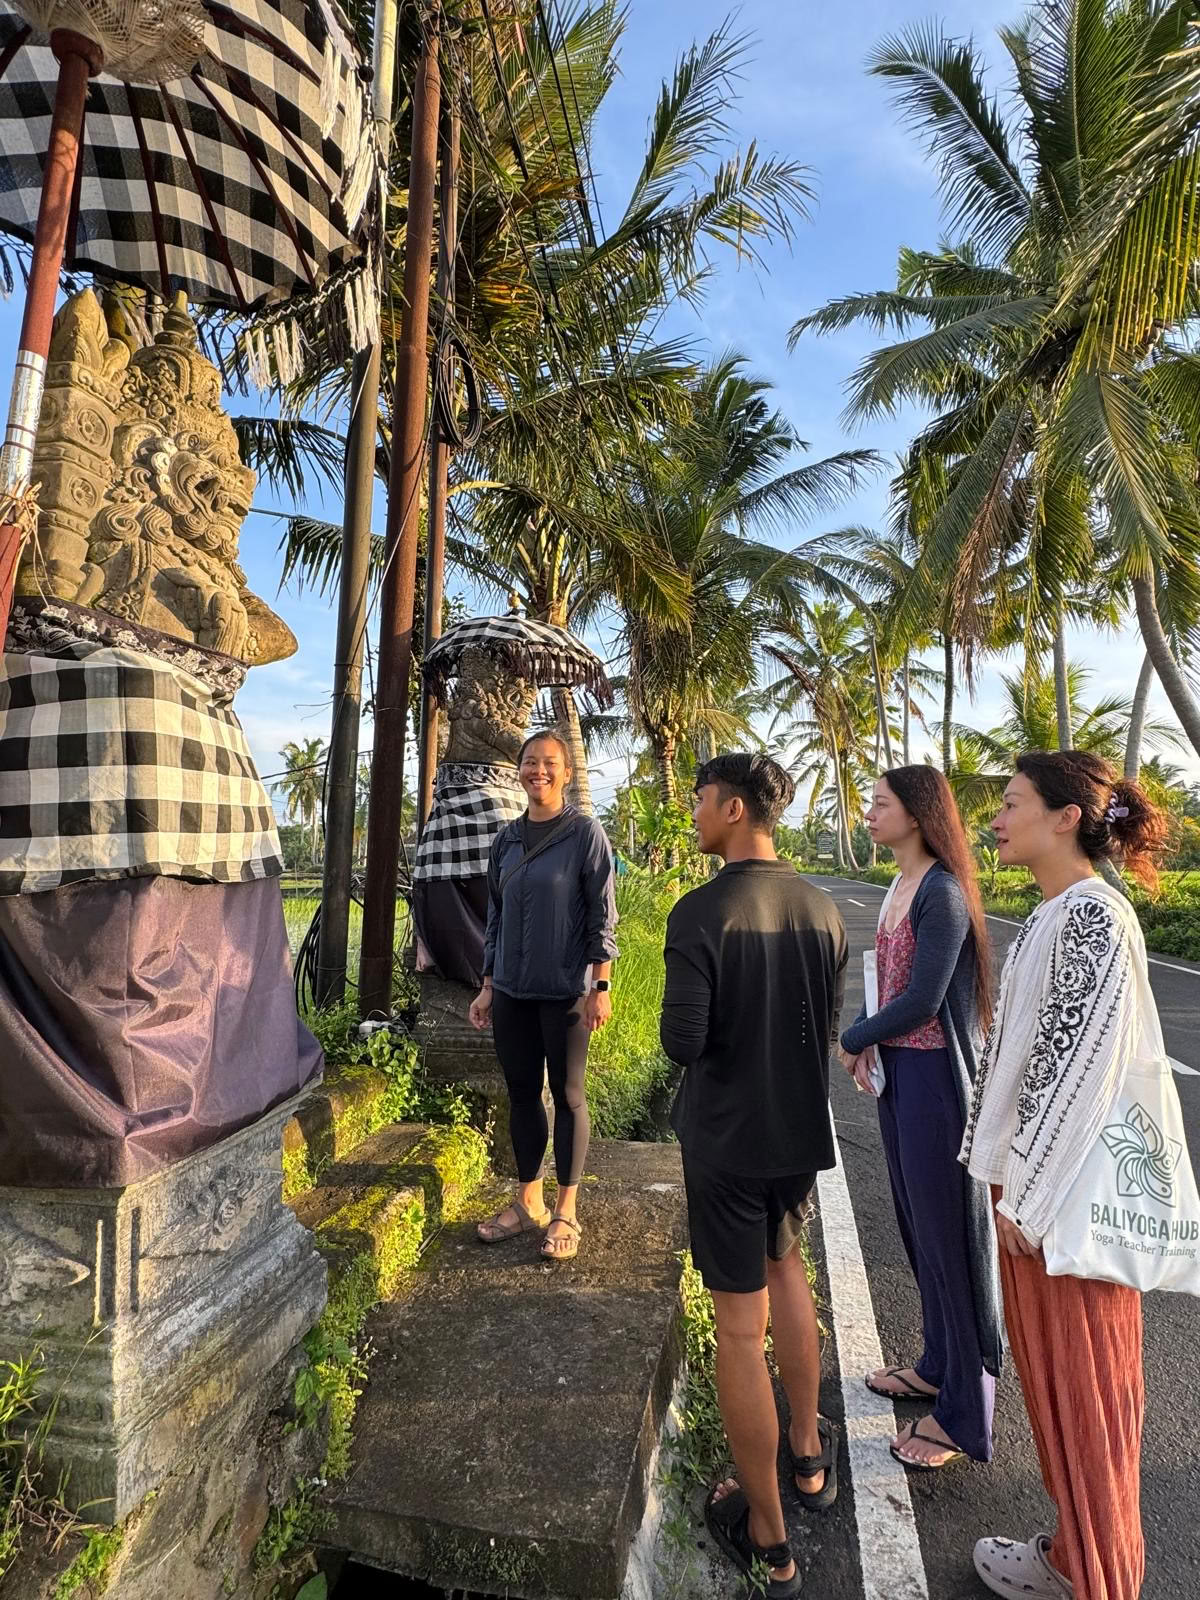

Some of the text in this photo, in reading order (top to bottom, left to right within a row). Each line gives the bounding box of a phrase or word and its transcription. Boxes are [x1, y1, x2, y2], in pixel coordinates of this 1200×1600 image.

[1091, 1230, 1197, 1258] Yoga Teacher Training
